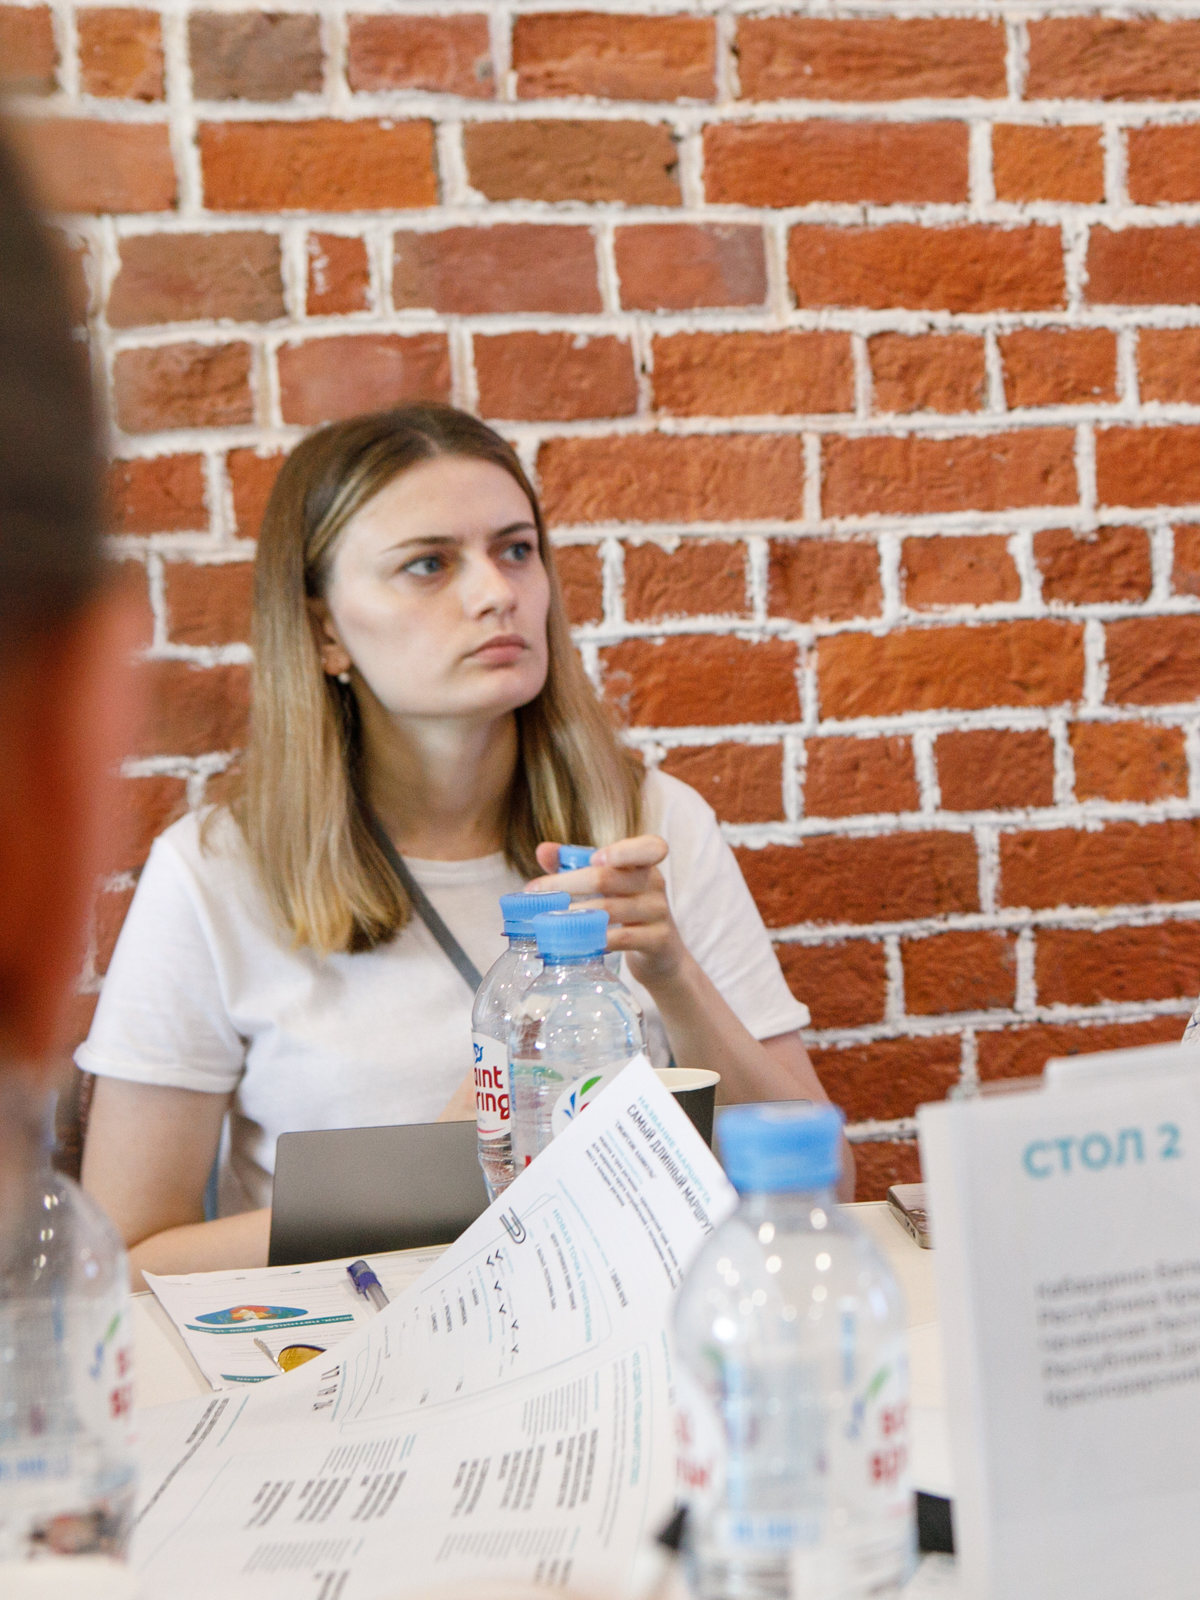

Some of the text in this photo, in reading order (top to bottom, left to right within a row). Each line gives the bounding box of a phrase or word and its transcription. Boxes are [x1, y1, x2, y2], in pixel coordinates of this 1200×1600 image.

[627, 1104, 714, 1235] САМЫЙ ДЛИННЫЙ МАРШРУТ
[1022, 1123, 1184, 1179] СТОЛ 2
